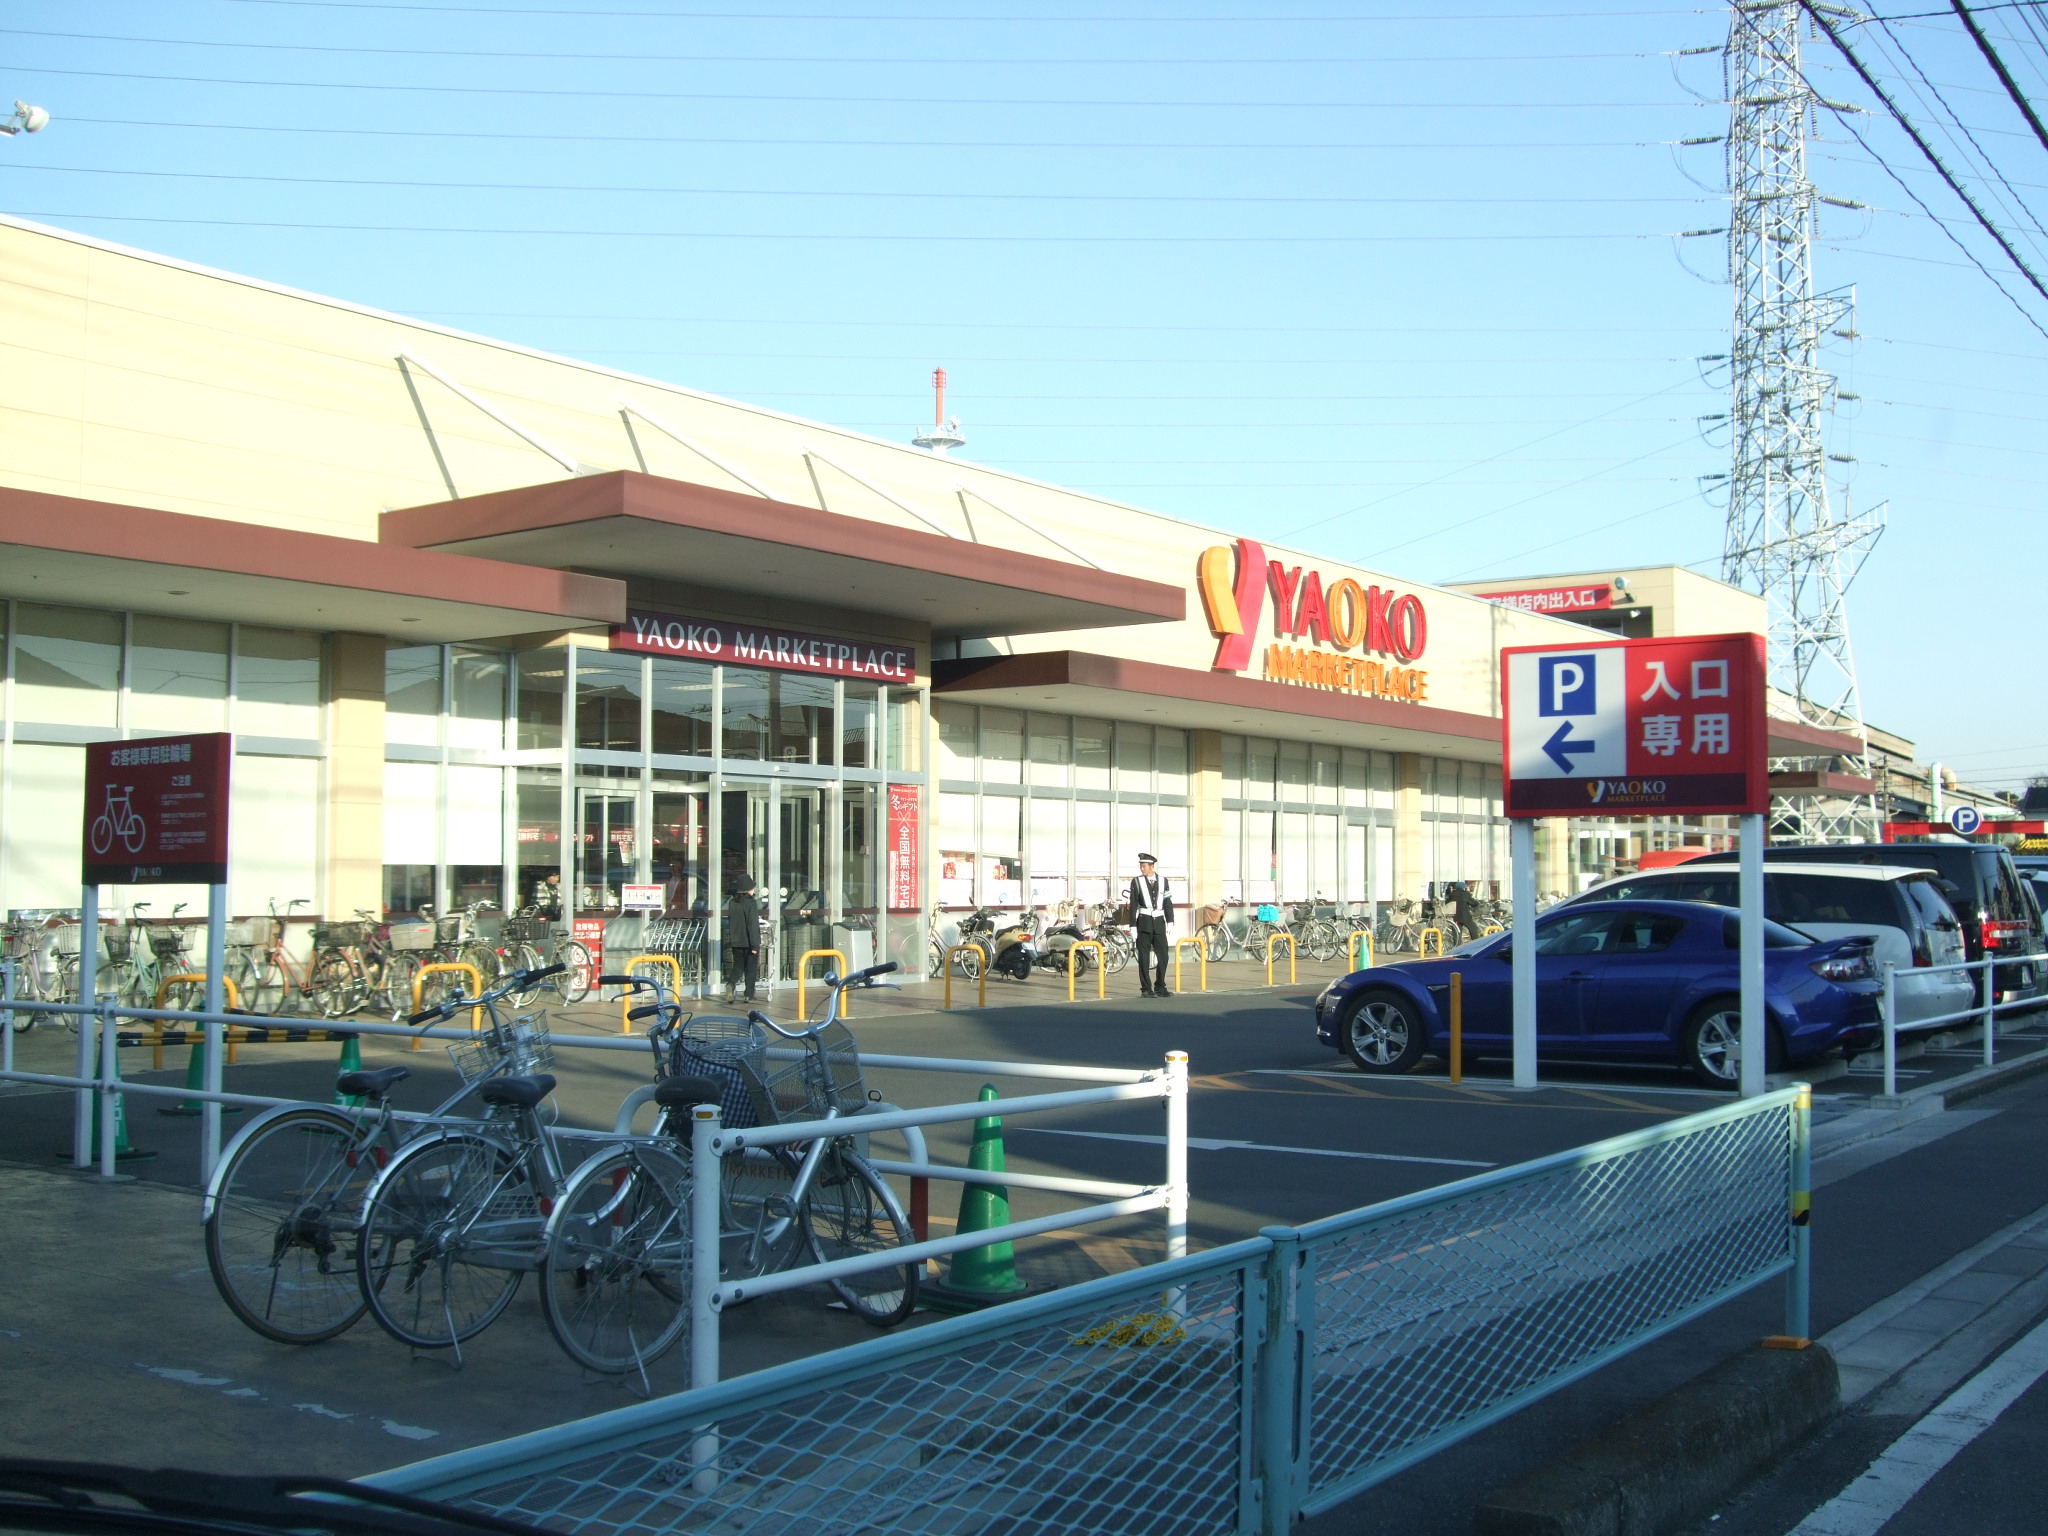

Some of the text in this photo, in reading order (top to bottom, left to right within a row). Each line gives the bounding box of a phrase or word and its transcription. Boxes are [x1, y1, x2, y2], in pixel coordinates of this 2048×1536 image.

[1268, 559, 1427, 661] YAOKO
[631, 616, 908, 678] YAOKO MARKETPLACE
[1269, 643, 1428, 701] MARKETPLACE
[1553, 662, 1585, 711] P
[1641, 659, 1729, 702] 入口
[110, 743, 191, 766] お客様専用駐輪場
[1641, 713, 1730, 757] 専用
[1606, 795, 1667, 803] MARKETPLACE
[1607, 780, 1667, 795] YAOKO
[1958, 809, 1975, 830] P
